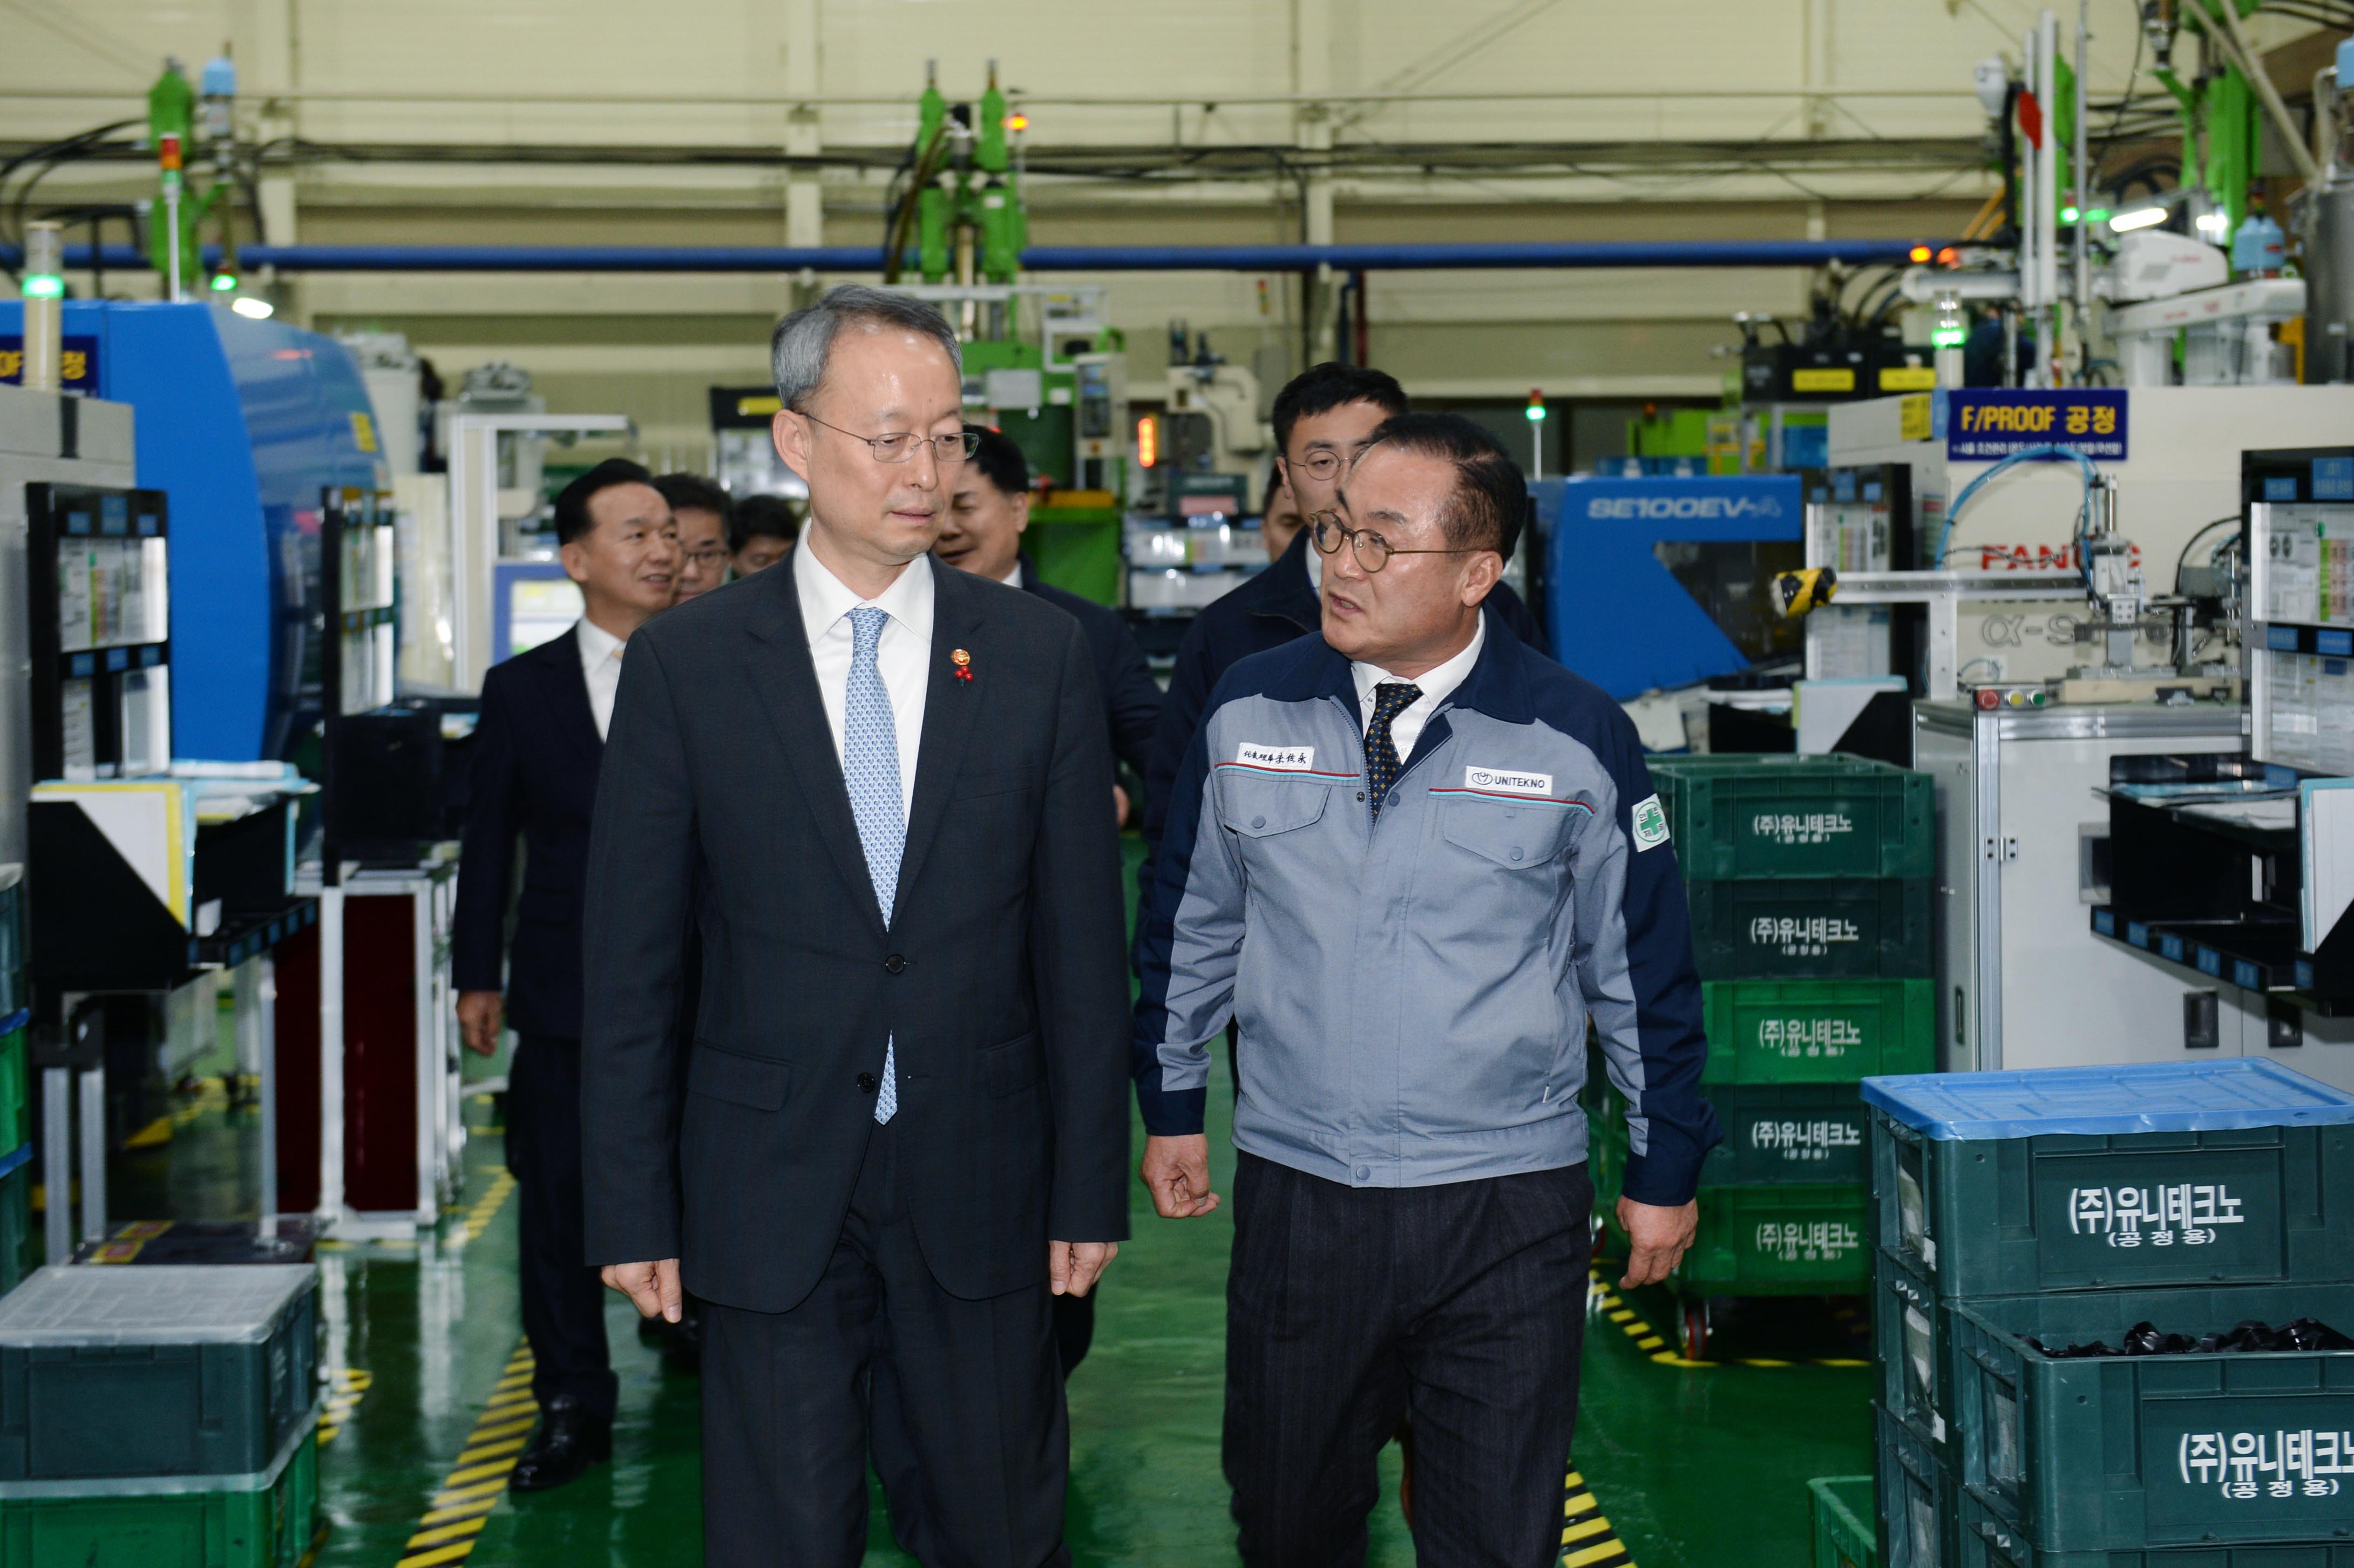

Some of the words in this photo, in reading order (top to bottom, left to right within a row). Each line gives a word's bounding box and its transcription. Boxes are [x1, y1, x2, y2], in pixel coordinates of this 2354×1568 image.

[1961, 406, 2055, 432] F/PROOF
[2066, 406, 2115, 434] 공정
[1495, 775, 1545, 788] UNITEKNO
[1753, 813, 1853, 836] (주)유니테크노
[1751, 917, 1859, 943] (주)유니테크노
[1759, 1019, 1861, 1048] (주)유니테크노
[1752, 1121, 1861, 1148] (주)유니테크노
[2070, 1184, 2244, 1234] (주)유니테크노
[1756, 1222, 1859, 1252] (주)유니테크노
